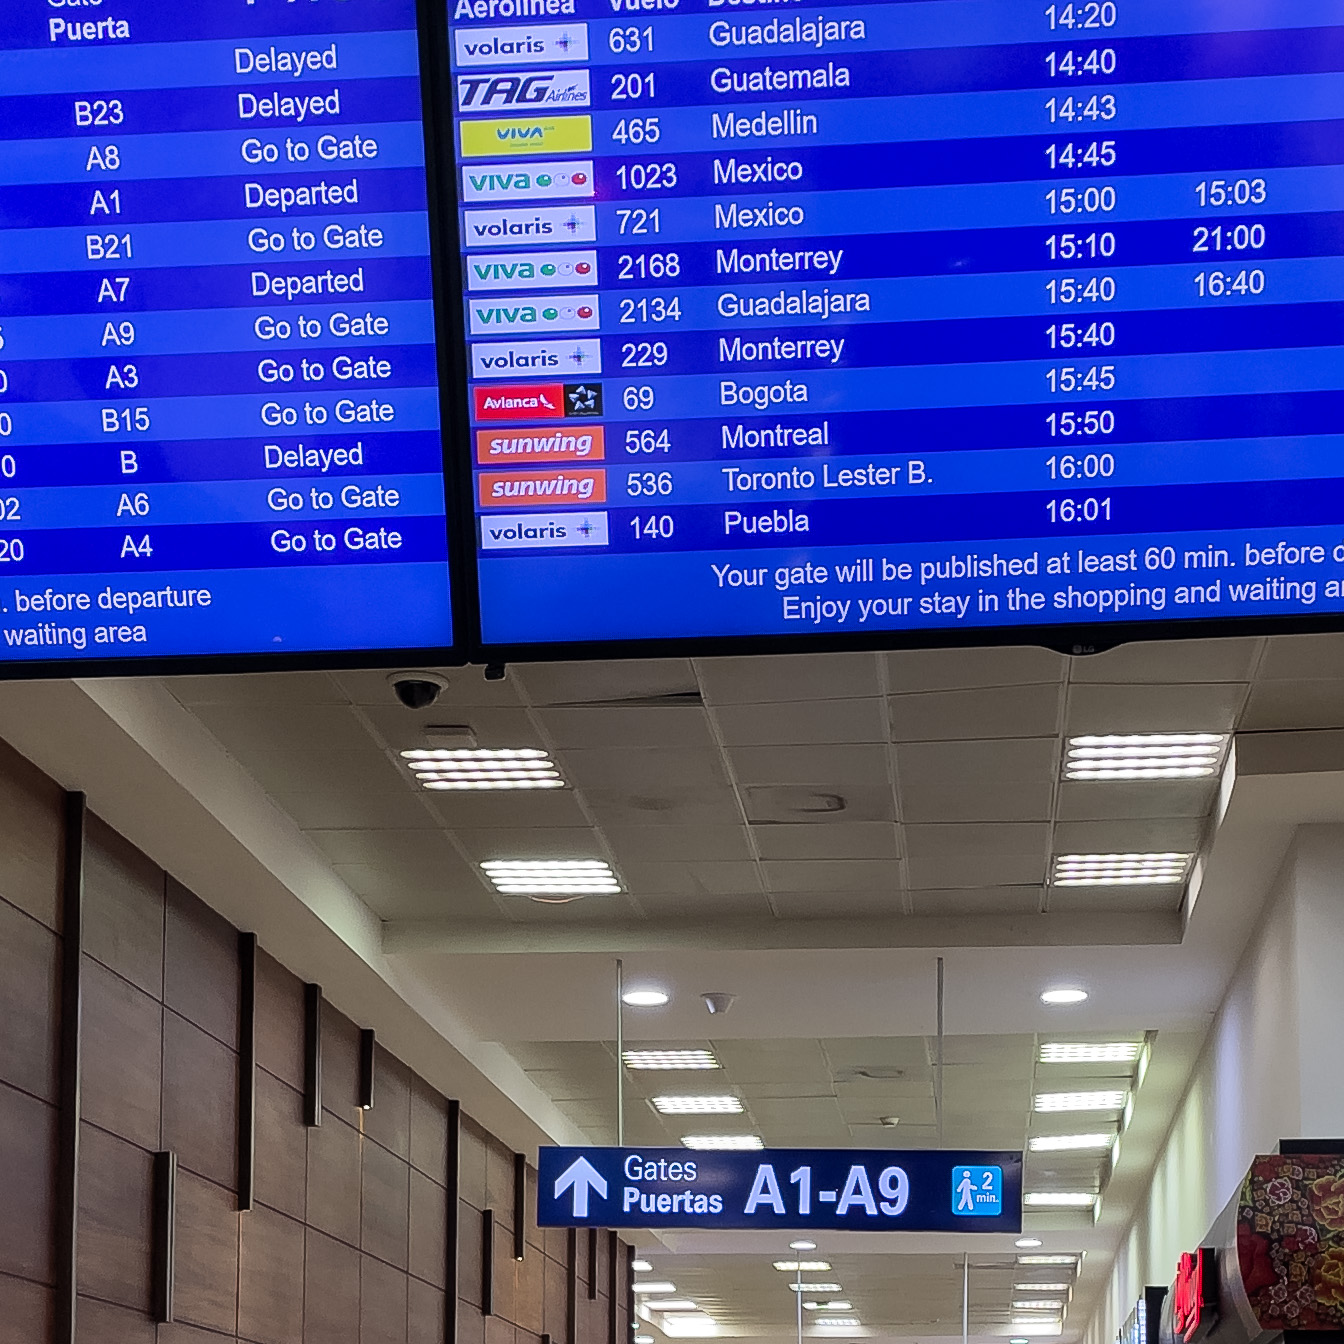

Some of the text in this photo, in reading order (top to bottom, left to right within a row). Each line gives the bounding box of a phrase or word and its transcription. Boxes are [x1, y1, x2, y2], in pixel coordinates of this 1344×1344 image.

[48, 16, 131, 42] Puerta
[460, 75, 554, 106] TAG
[611, 72, 655, 100] 201
[710, 61, 850, 93] Guatemala
[1045, 48, 1116, 77] 14:40
[74, 99, 124, 126] B23
[237, 88, 340, 123] Delayed
[90, 189, 121, 215] A1
[244, 178, 359, 213] Departed
[473, 215, 553, 237] volaris
[616, 208, 660, 235] 721
[715, 201, 804, 229] Mexico
[1045, 186, 1116, 214] 15:00
[1195, 178, 1267, 207] 15:03
[86, 233, 132, 260] B21
[248, 227, 285, 252] Go
[291, 227, 316, 251] to
[323, 224, 384, 249] Gate
[97, 277, 130, 303] A7
[251, 267, 364, 301] Departed
[623, 386, 654, 410] 69
[720, 379, 808, 410] Bogota
[1046, 365, 1115, 393] 15:45
[488, 433, 593, 458] sunwing
[625, 428, 672, 454] 564
[721, 420, 829, 449] Montreal
[1045, 410, 1115, 437] 15:50
[120, 450, 138, 474] B
[264, 441, 364, 473] Delayed
[490, 475, 595, 500] sunwing
[627, 471, 673, 496] 536
[721, 466, 815, 492] Toronto
[823, 463, 901, 488] Lester
[908, 460, 933, 484] B.
[1046, 453, 1115, 480] 16:00
[15, 588, 91, 612] before
[97, 585, 212, 615] departure
[784, 596, 850, 624] Enjoy
[858, 597, 913, 623] your
[919, 591, 971, 619] stay
[978, 589, 999, 612] in
[1006, 587, 1046, 611] the
[1053, 582, 1166, 613] shopping
[1174, 579, 1221, 604] and
[1228, 576, 1317, 605] waiting
[623, 1155, 994, 1217] Gates A1-A9 2
[623, 1188, 724, 1215] Puertas
